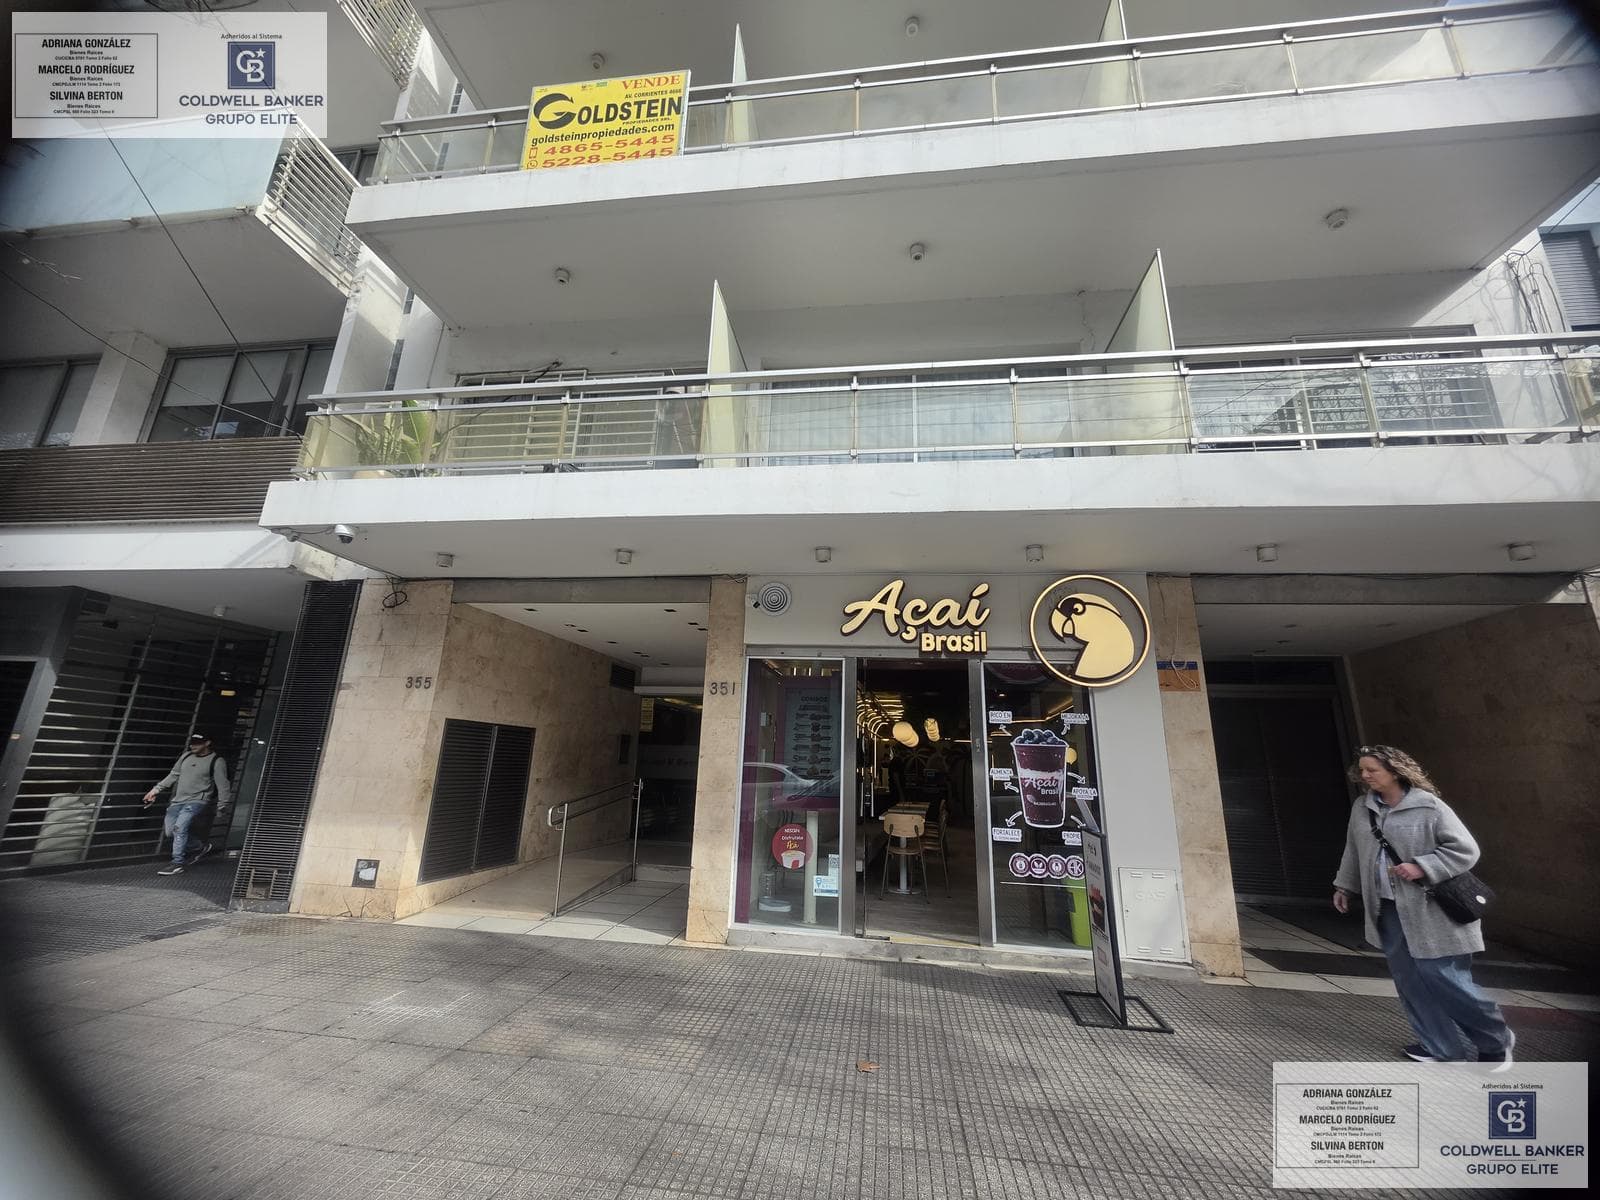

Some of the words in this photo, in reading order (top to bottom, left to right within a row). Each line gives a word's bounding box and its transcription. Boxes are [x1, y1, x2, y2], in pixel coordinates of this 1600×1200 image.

[622, 74, 680, 90] VENDE
[534, 93, 682, 130] GOLDSTEIN
[532, 123, 675, 146] goldsteinpropiedades.com
[544, 134, 675, 156] 4865-5445
[542, 147, 673, 168] 5228-5445
[840, 579, 990, 642] Açaí
[920, 632, 988, 652] Brasil
[405, 676, 432, 689] 355
[710, 682, 735, 695] 351
